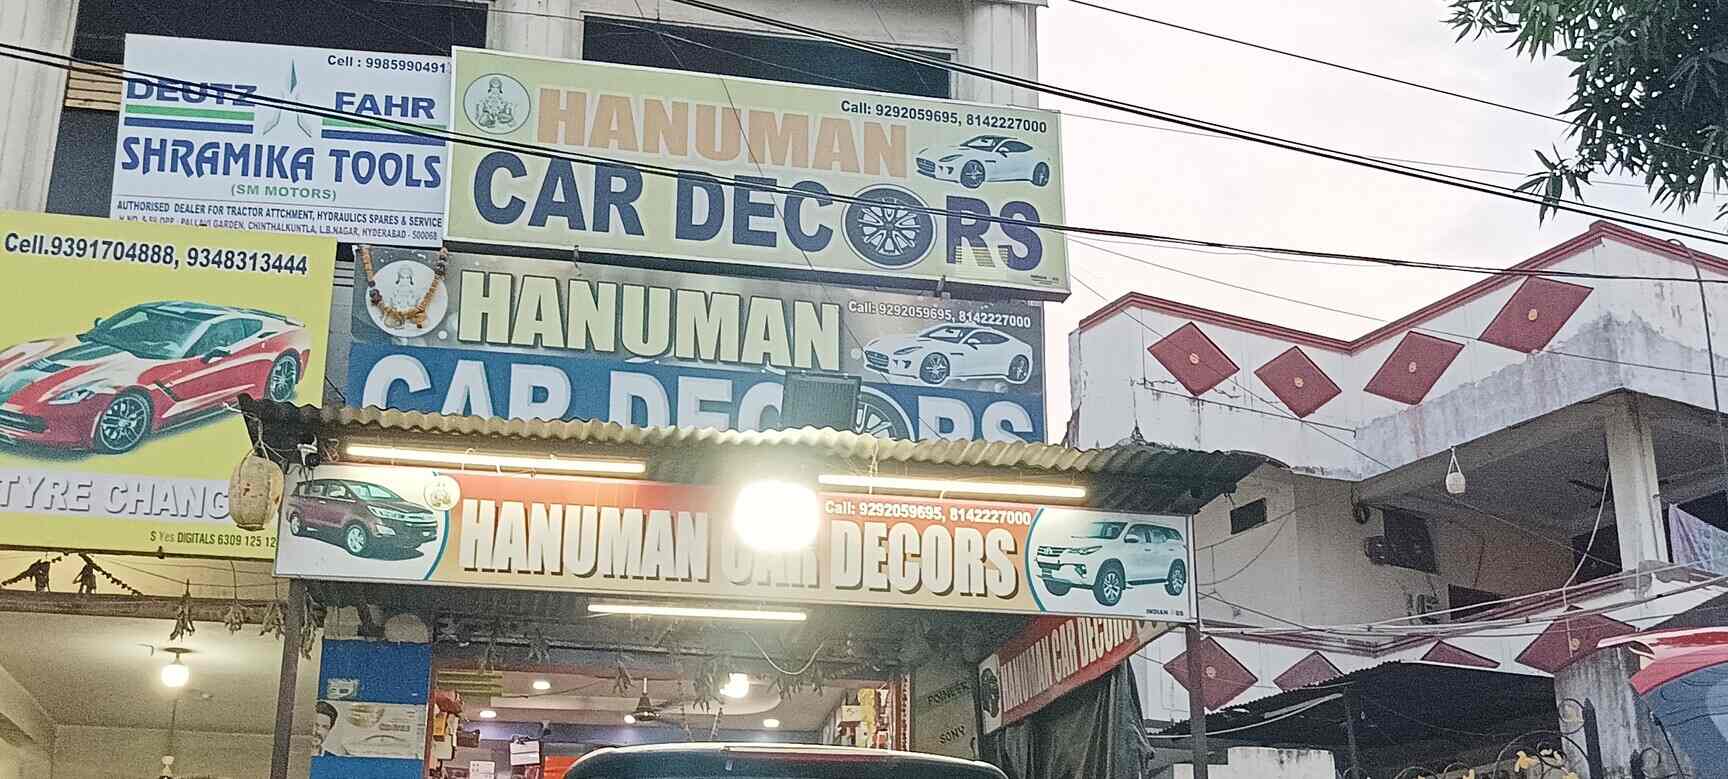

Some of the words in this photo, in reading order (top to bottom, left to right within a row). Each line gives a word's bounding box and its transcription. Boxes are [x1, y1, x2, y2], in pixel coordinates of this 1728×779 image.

[327, 55, 353, 67] Cell
[366, 57, 446, 73] 9985990491
[126, 77, 257, 107] DEUTZ
[334, 91, 436, 119] FAHR
[841, 100, 872, 115] Call:
[875, 104, 962, 126] 9292059695,
[966, 114, 1047, 133] 8142227000
[536, 87, 908, 178] HANUMAN
[121, 136, 315, 183] SHRAMIKA
[329, 149, 442, 188] TOOLS
[231, 184, 261, 198] (SM
[265, 186, 337, 201] MOTORS)
[474, 151, 645, 237] CAR
[117, 201, 170, 213] AUTHORISED
[174, 203, 206, 214] DEALER
[208, 205, 223, 215] FOR
[226, 206, 263, 217] TRACTOR
[317, 210, 367, 223] HYDRAULICS
[369, 214, 399, 226] SPARES
[409, 216, 442, 228] SERVICE
[186, 247, 308, 275] 9348313444
[457, 269, 840, 371] HANUMAN
[958, 312, 1032, 329] 8142227000
[0, 475, 93, 512] TYRE
[825, 500, 856, 515] Call:
[950, 508, 1031, 526] 8142227000
[177, 532, 216, 545] DIGITALS
[218, 534, 241, 546] 6309
[245, 535, 262, 547] 125
[460, 498, 711, 584] HANUMAN
[830, 518, 1020, 600] DECORS
[1000, 635, 1054, 712] HANUMAN
[1051, 619, 1080, 682] CAR
